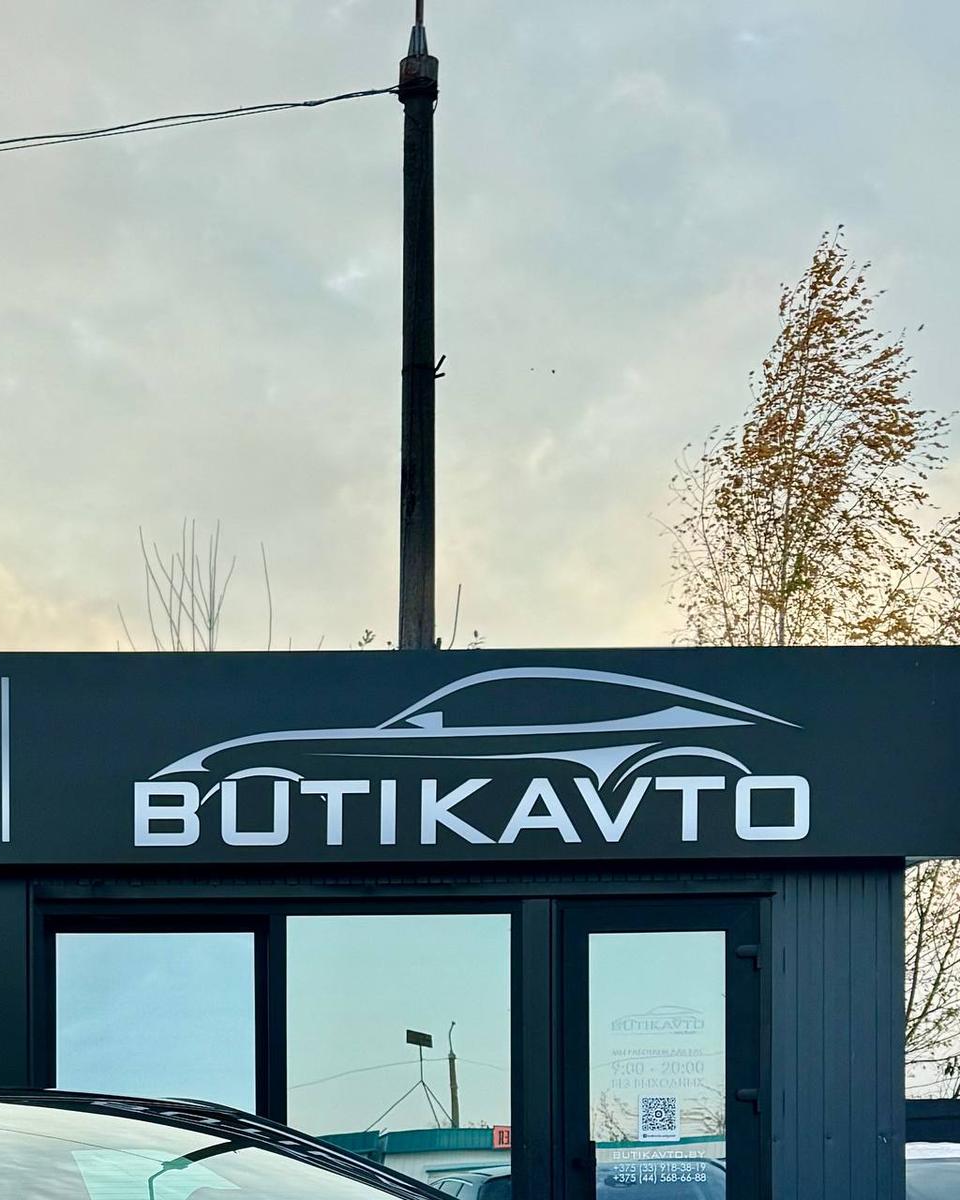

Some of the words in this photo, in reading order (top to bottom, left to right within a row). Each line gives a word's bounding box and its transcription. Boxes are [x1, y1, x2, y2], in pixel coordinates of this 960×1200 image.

[133, 774, 811, 847] BUTIKAVTO
[611, 1018, 704, 1031] BUTIKAVTO
[611, 1061, 645, 1075] 9:00
[661, 1060, 705, 1075] 20:00
[613, 1150, 706, 1160] BUTIKAVTO.BY
[613, 1163, 636, 1172] +375
[639, 1163, 657, 1174] (33)
[660, 1163, 706, 1172] 918-38-19
[613, 1173, 636, 1182] +375
[639, 1173, 657, 1184] (44)
[660, 1173, 707, 1182] 568-66-88
